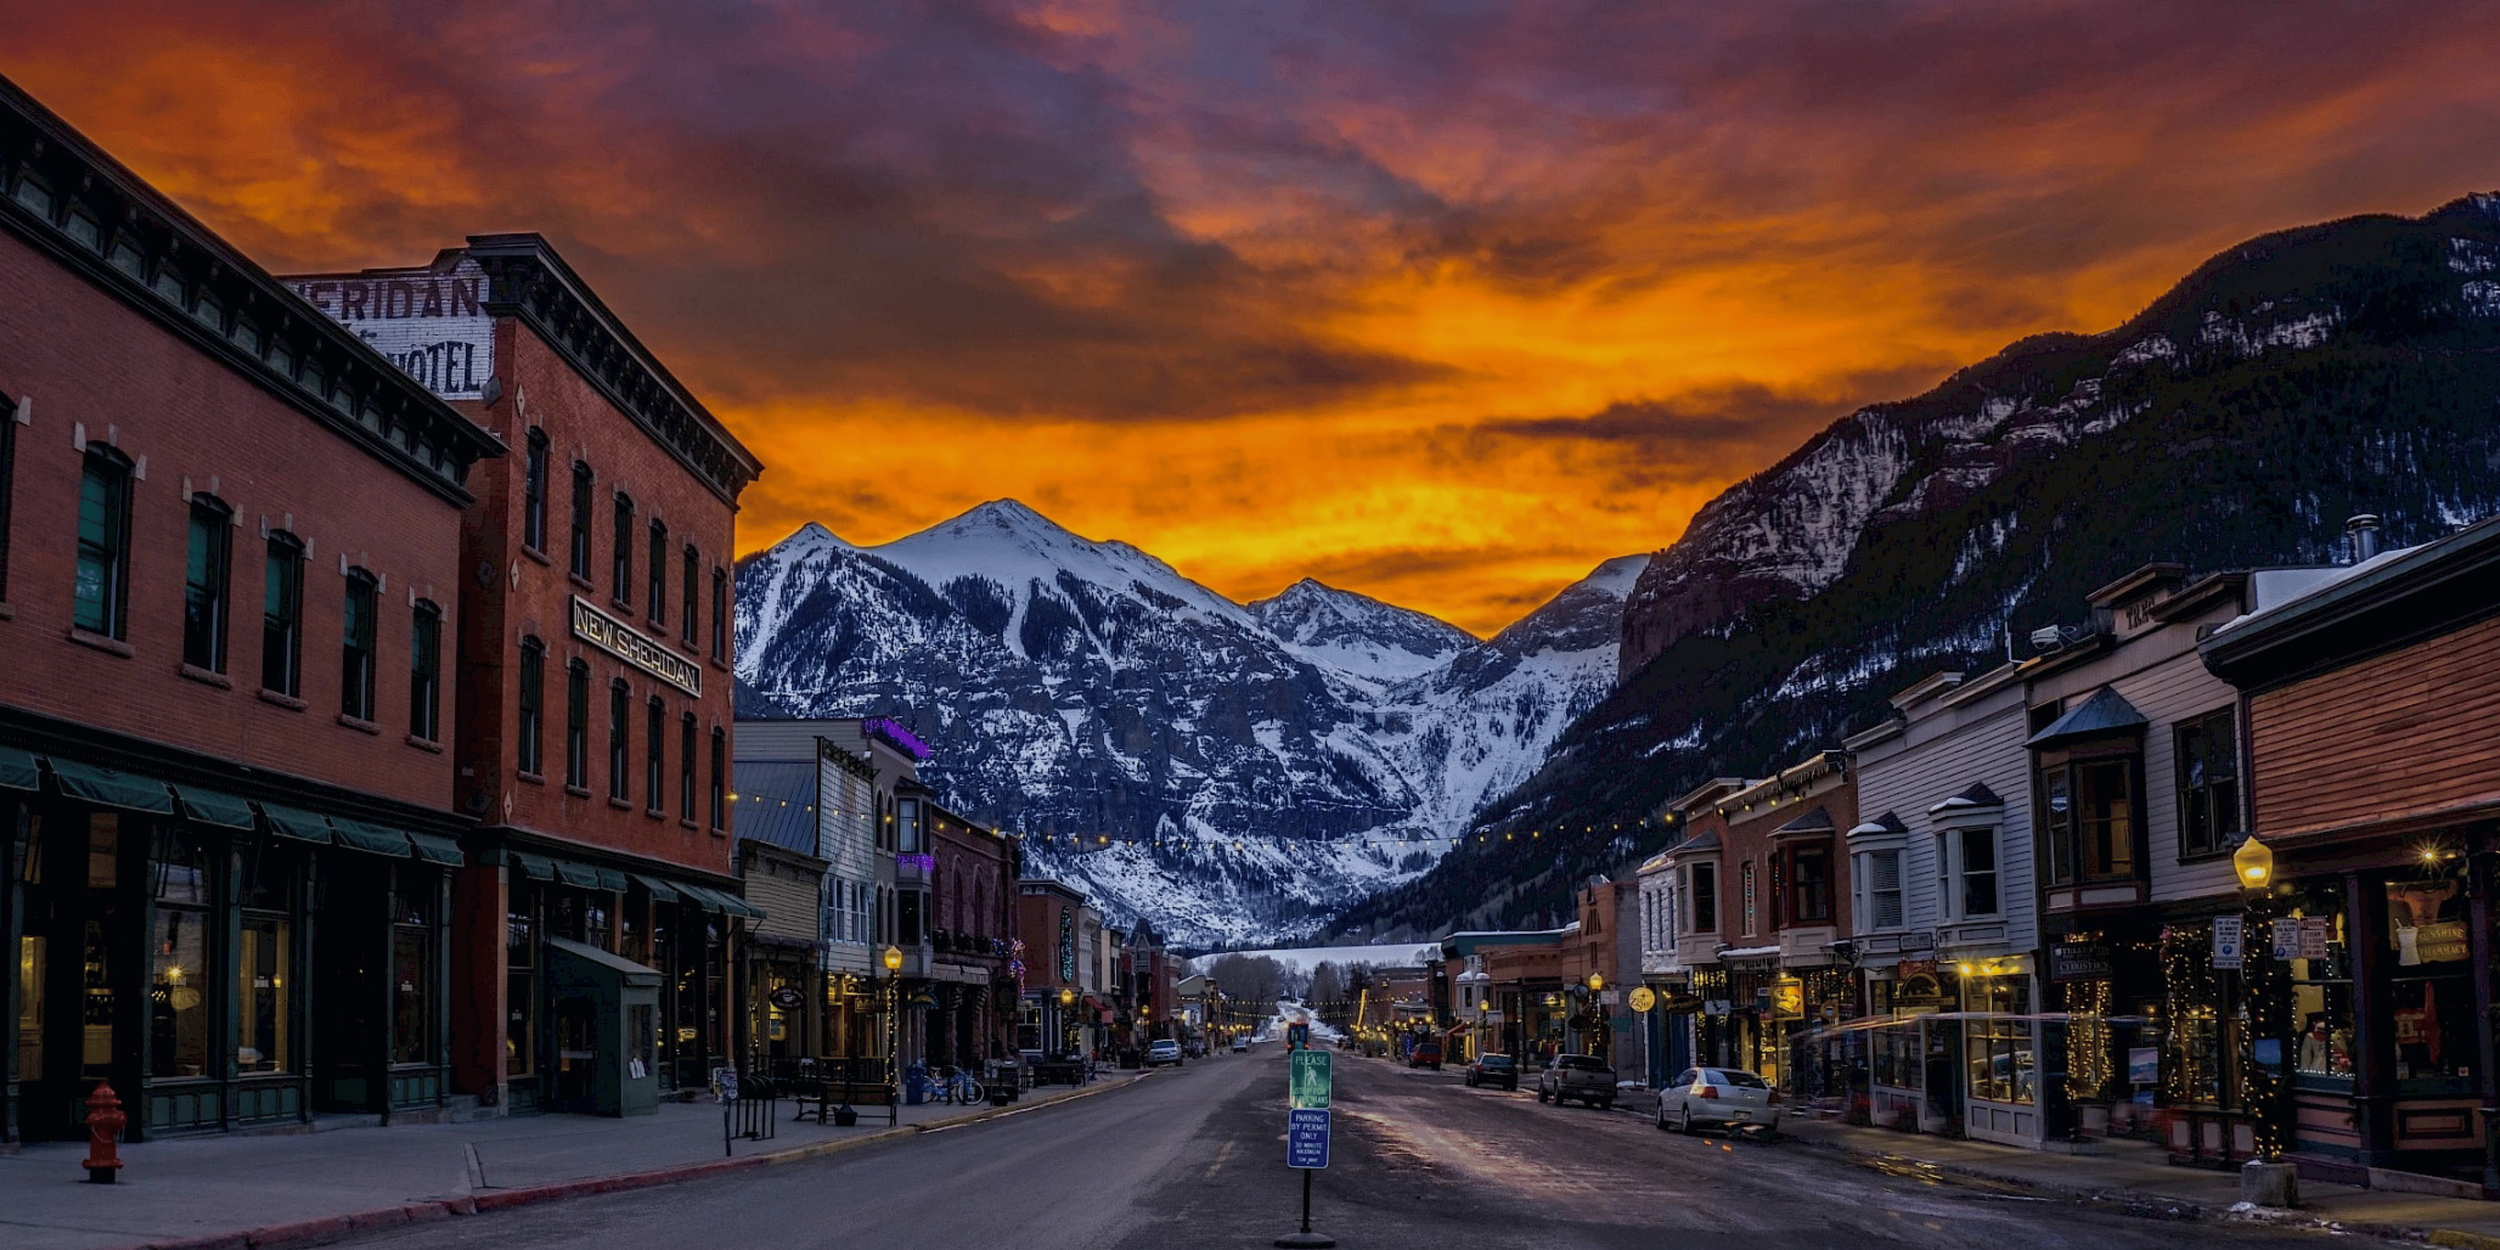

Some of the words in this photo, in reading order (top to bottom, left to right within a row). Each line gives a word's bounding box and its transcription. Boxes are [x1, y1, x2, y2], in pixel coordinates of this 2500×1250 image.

[299, 279, 480, 320] ERIDAN
[575, 605, 614, 646] NEW
[616, 629, 699, 690] SHERIDAN
[2418, 944, 2467, 958] PHARMACY
[1295, 1055, 1327, 1066] PLEASE
[1295, 1113, 1325, 1123] PARKING
[1291, 1122, 1301, 1131] BY
[1302, 1122, 1327, 1132] PERMIT
[1300, 1131, 1318, 1140] ONLY
